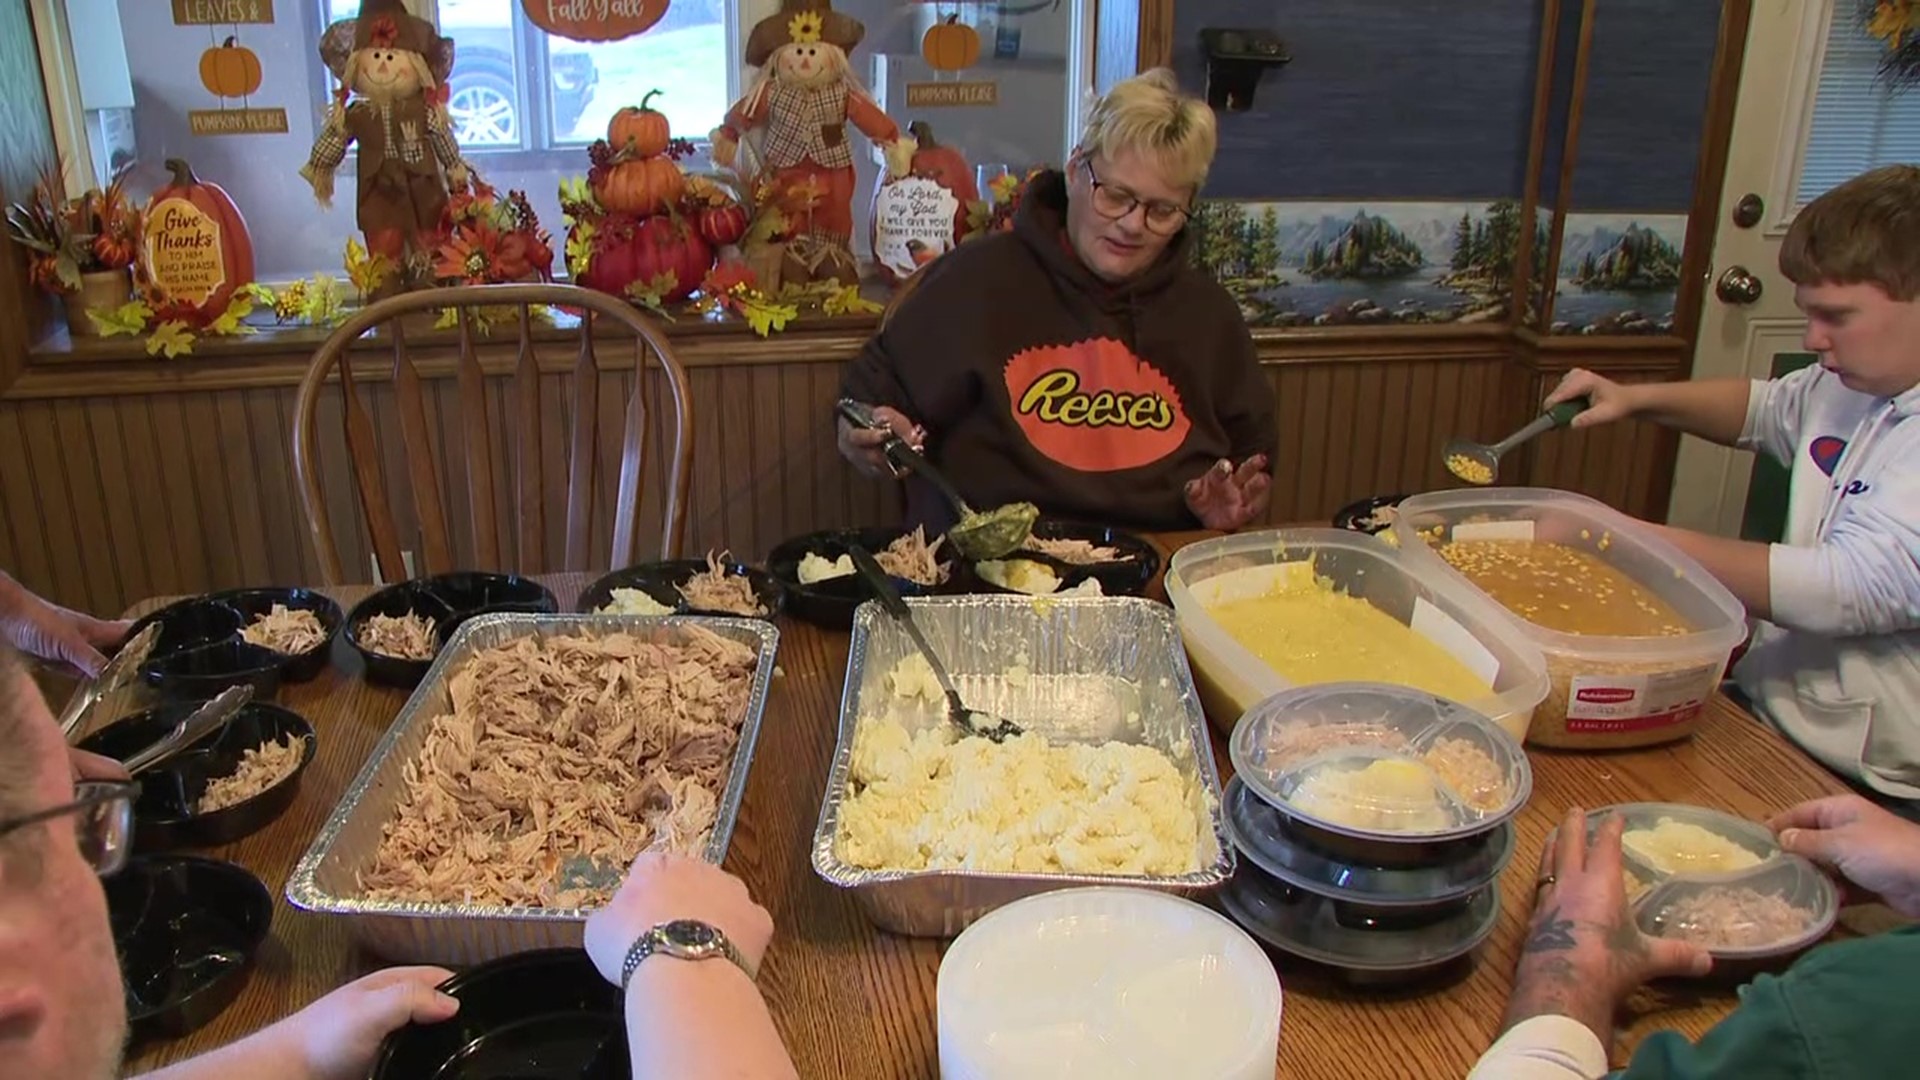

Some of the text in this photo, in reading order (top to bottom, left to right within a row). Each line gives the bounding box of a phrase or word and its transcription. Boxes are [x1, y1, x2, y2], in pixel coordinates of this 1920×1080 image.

[184, 0, 259, 22] LEAVES &
[547, 0, 591, 23] Fall
[909, 86, 993, 101] PUMPKINS PLEASE
[192, 112, 285, 131] PUMPKINS PLEASE
[890, 204, 907, 216] my
[165, 208, 200, 231] Give
[888, 218, 903, 226] WILL
[907, 218, 925, 227] GIVE
[929, 217, 949, 227] YOU
[879, 226, 950, 239] THANKS FOREVER
[155, 229, 213, 252] Thanks
[169, 251, 182, 261] TO
[160, 260, 216, 273] AND PRAISE
[182, 273, 209, 282] NAME
[1019, 369, 1174, 430] Reese's
